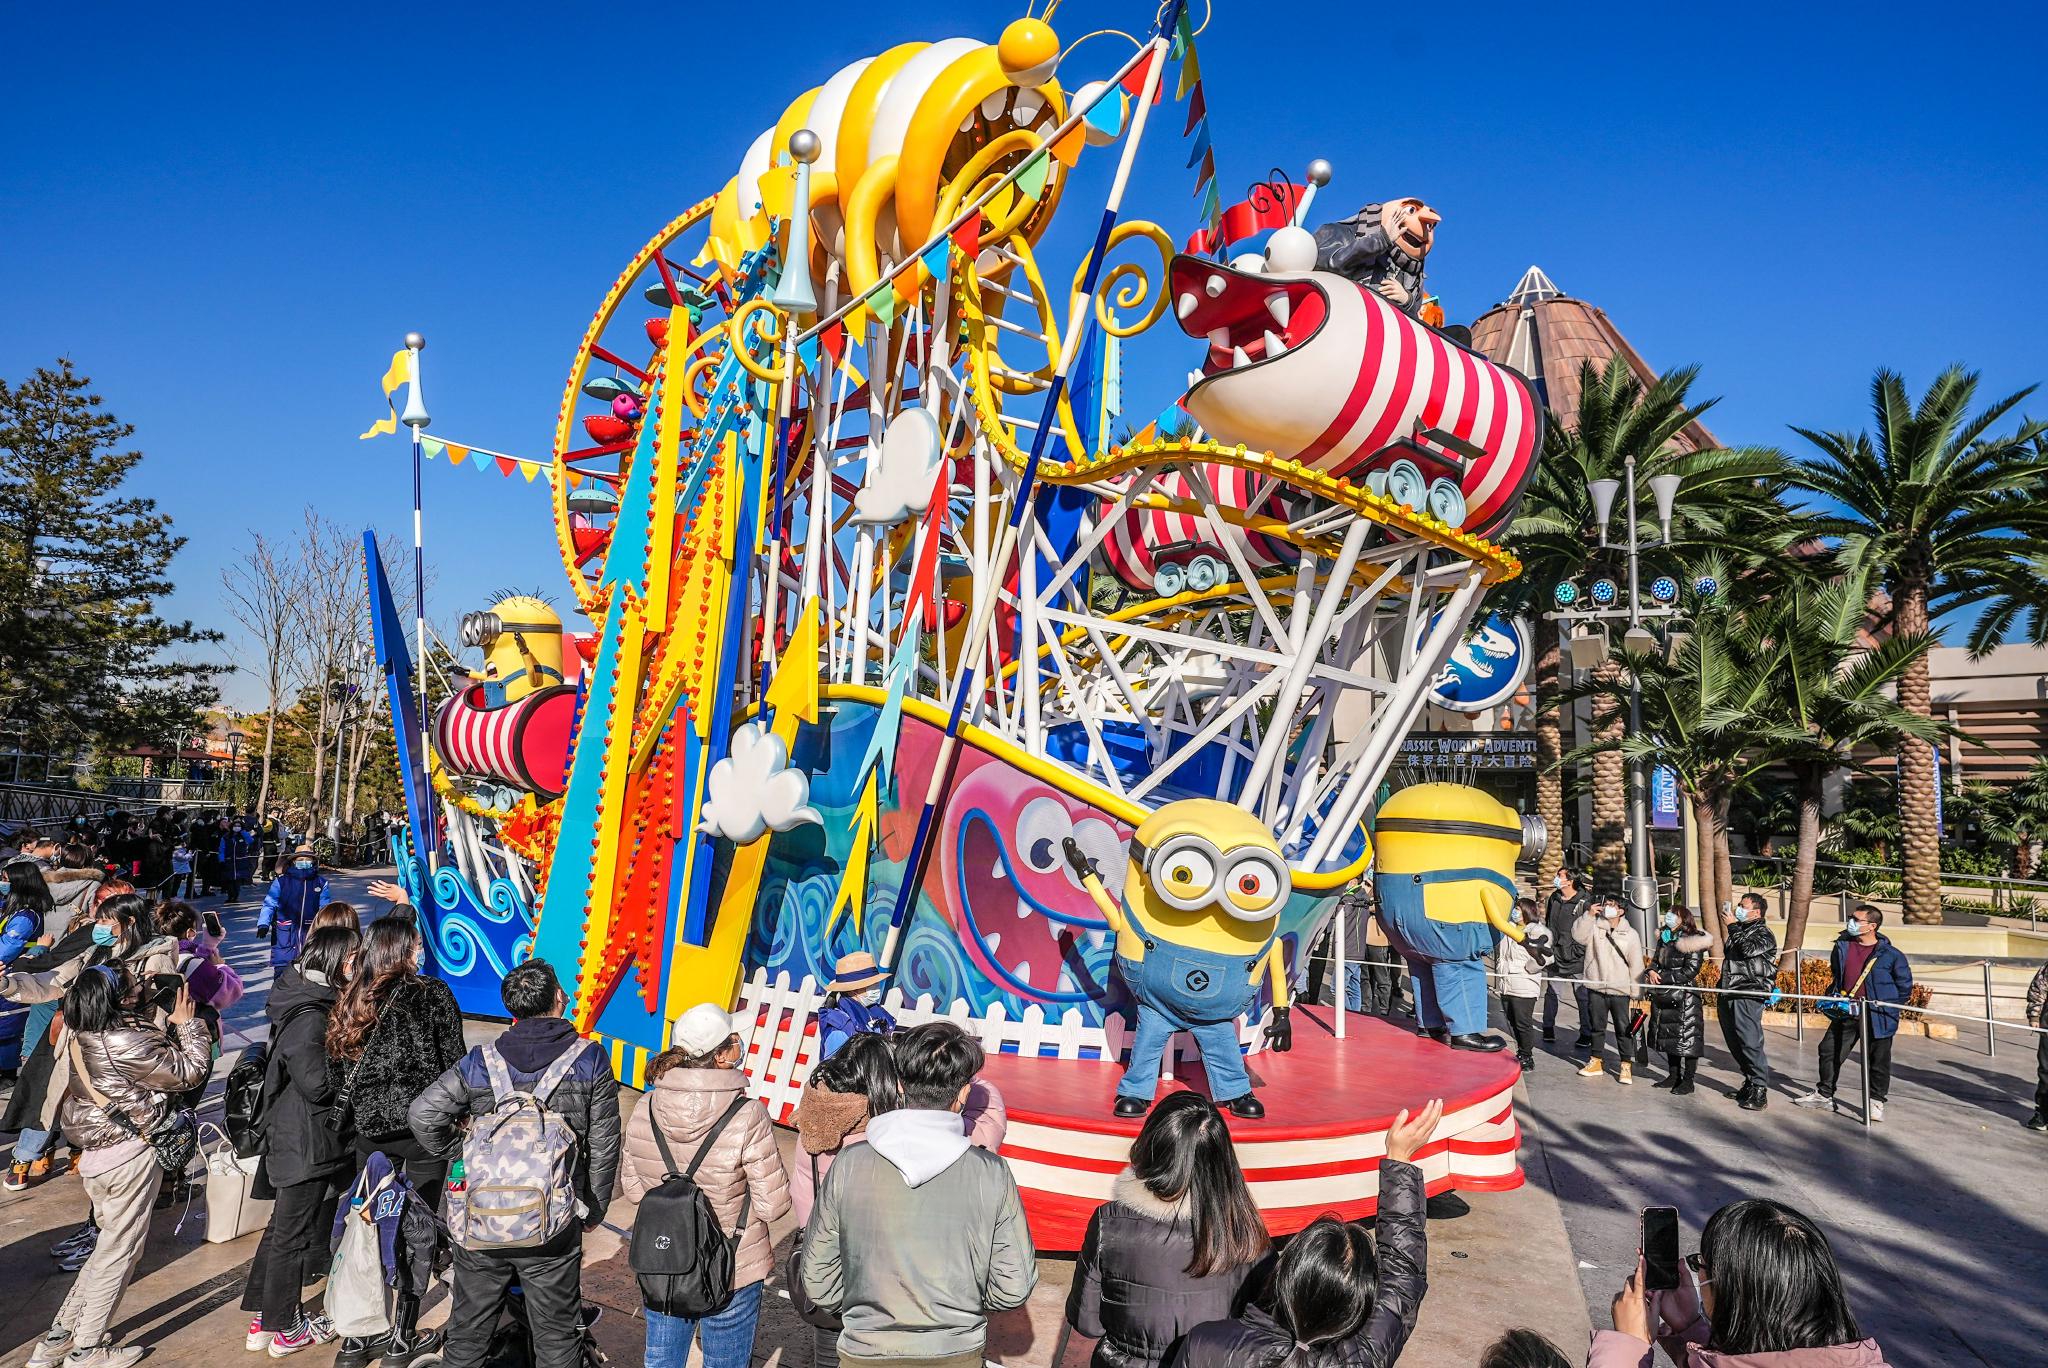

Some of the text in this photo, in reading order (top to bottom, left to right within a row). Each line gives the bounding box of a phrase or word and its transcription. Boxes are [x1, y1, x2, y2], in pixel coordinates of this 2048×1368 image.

[1400, 738, 1537, 754] RASSIC WORLD ADVENT
[1407, 754, 1533, 768] 侏罗纪世界大冒险
[1662, 791, 1675, 813] ISLA
[374, 1189, 406, 1221] GA
